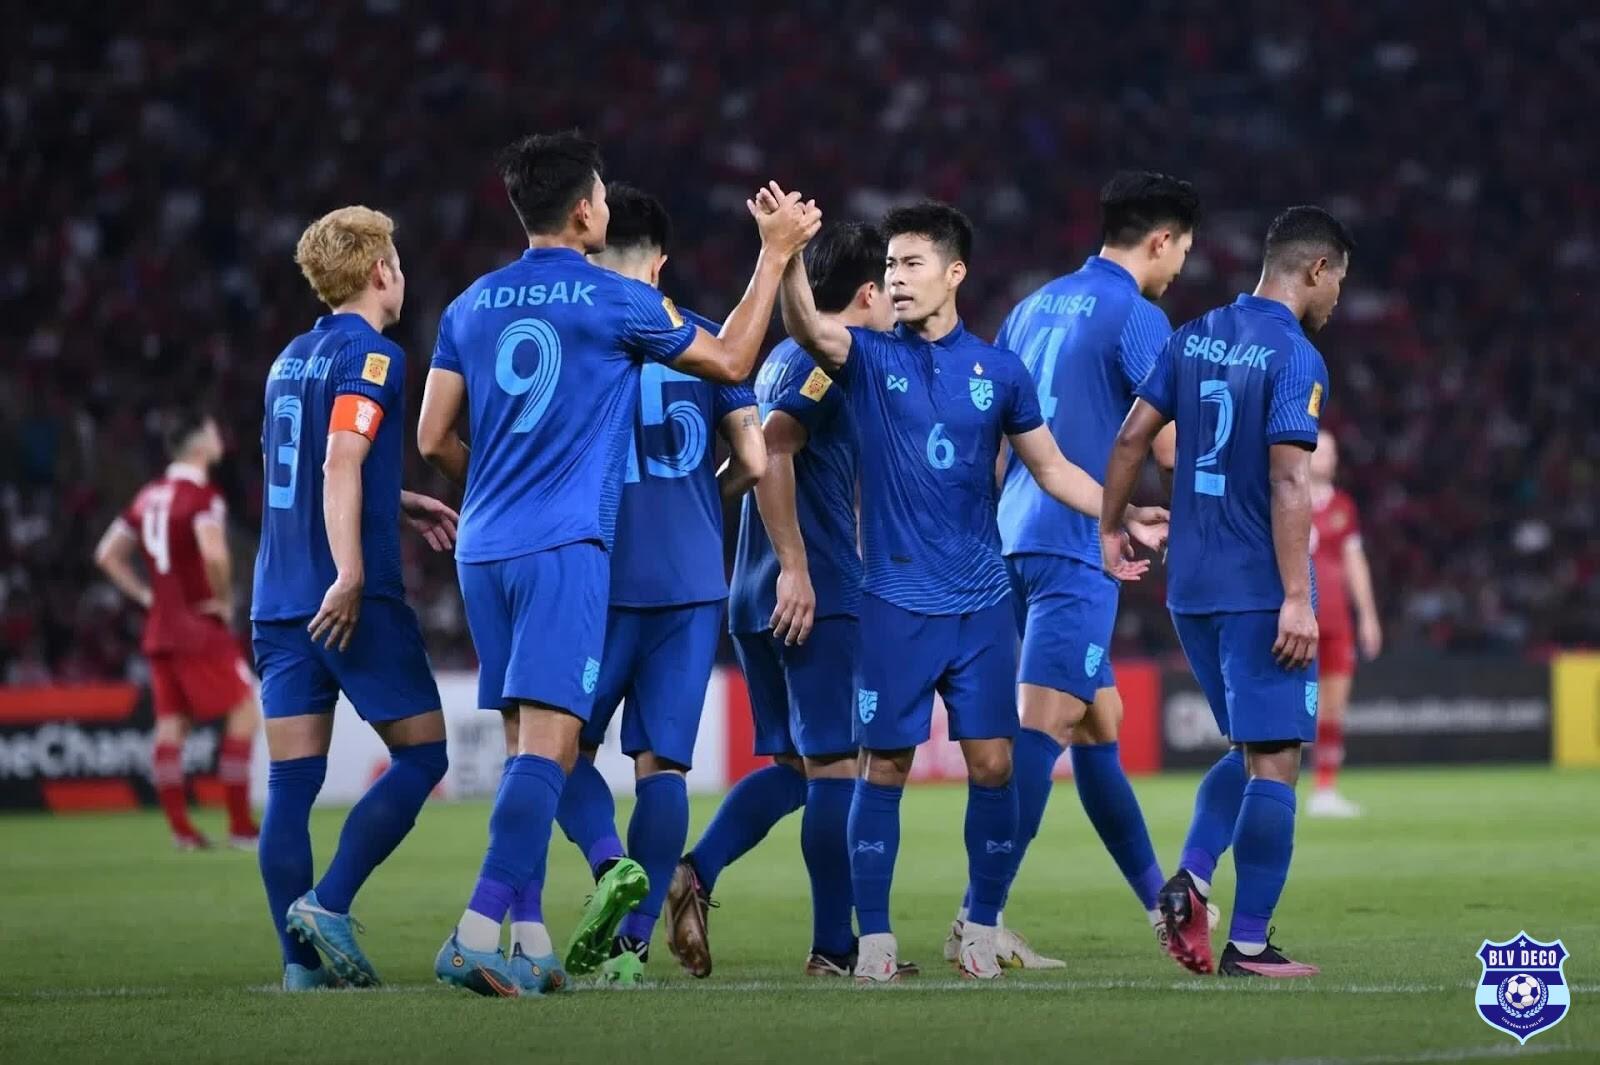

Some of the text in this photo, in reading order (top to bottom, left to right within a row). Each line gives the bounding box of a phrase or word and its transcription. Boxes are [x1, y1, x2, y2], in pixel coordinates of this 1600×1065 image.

[473, 281, 597, 311] ADISAK
[495, 317, 562, 433] 9
[623, 361, 708, 483] 5
[268, 394, 302, 510] 3
[926, 422, 956, 470] 6
[1194, 379, 1234, 497] 2
